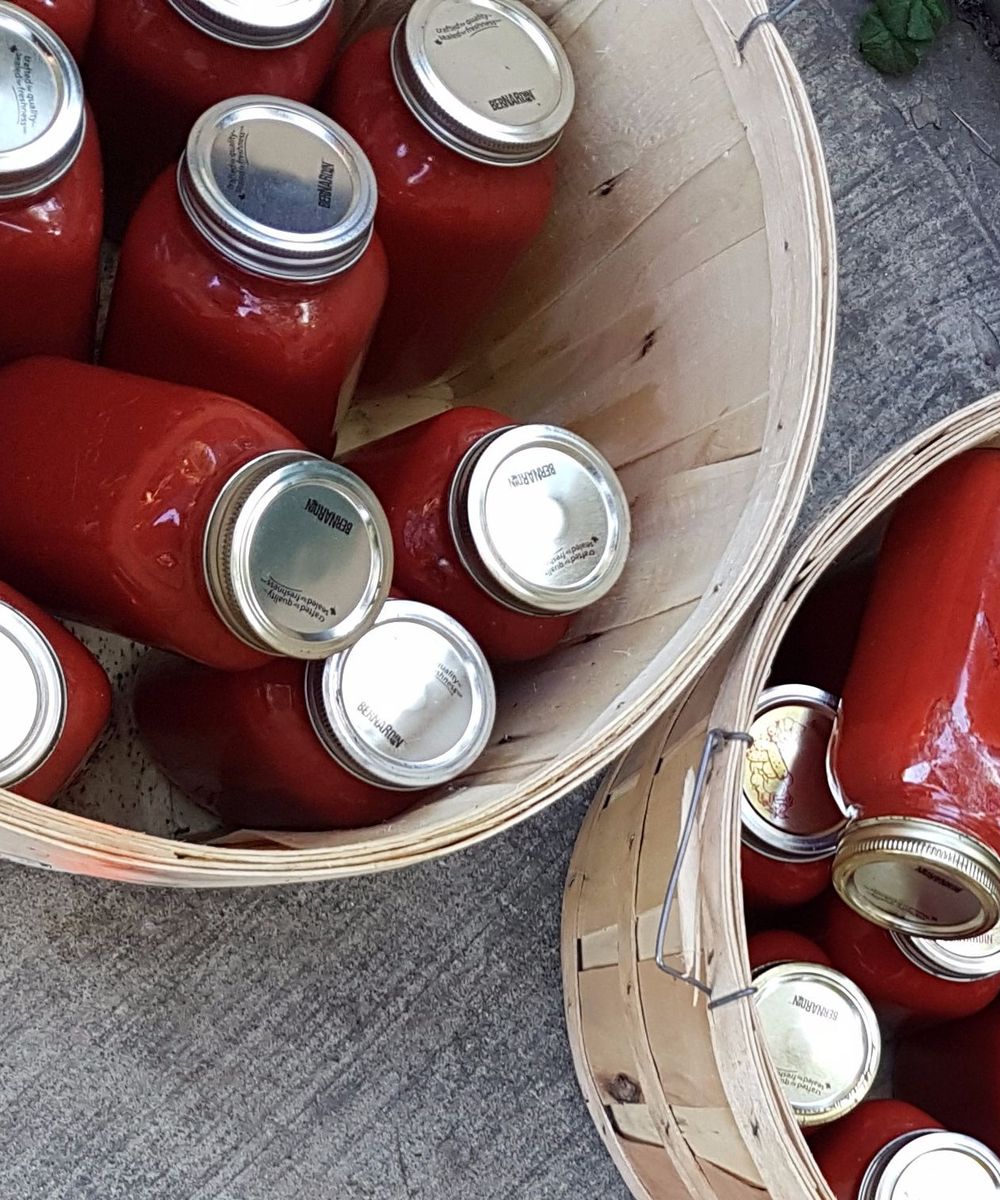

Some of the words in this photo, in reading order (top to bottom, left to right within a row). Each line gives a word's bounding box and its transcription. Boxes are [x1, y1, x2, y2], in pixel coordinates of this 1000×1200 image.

[488, 89, 536, 111] BERNARDIN
[318, 160, 334, 209] BERNARDIN
[508, 463, 556, 488] BERNARDIN
[304, 498, 354, 536] BERNARDIN
[792, 994, 839, 1021] BERNARDIN
